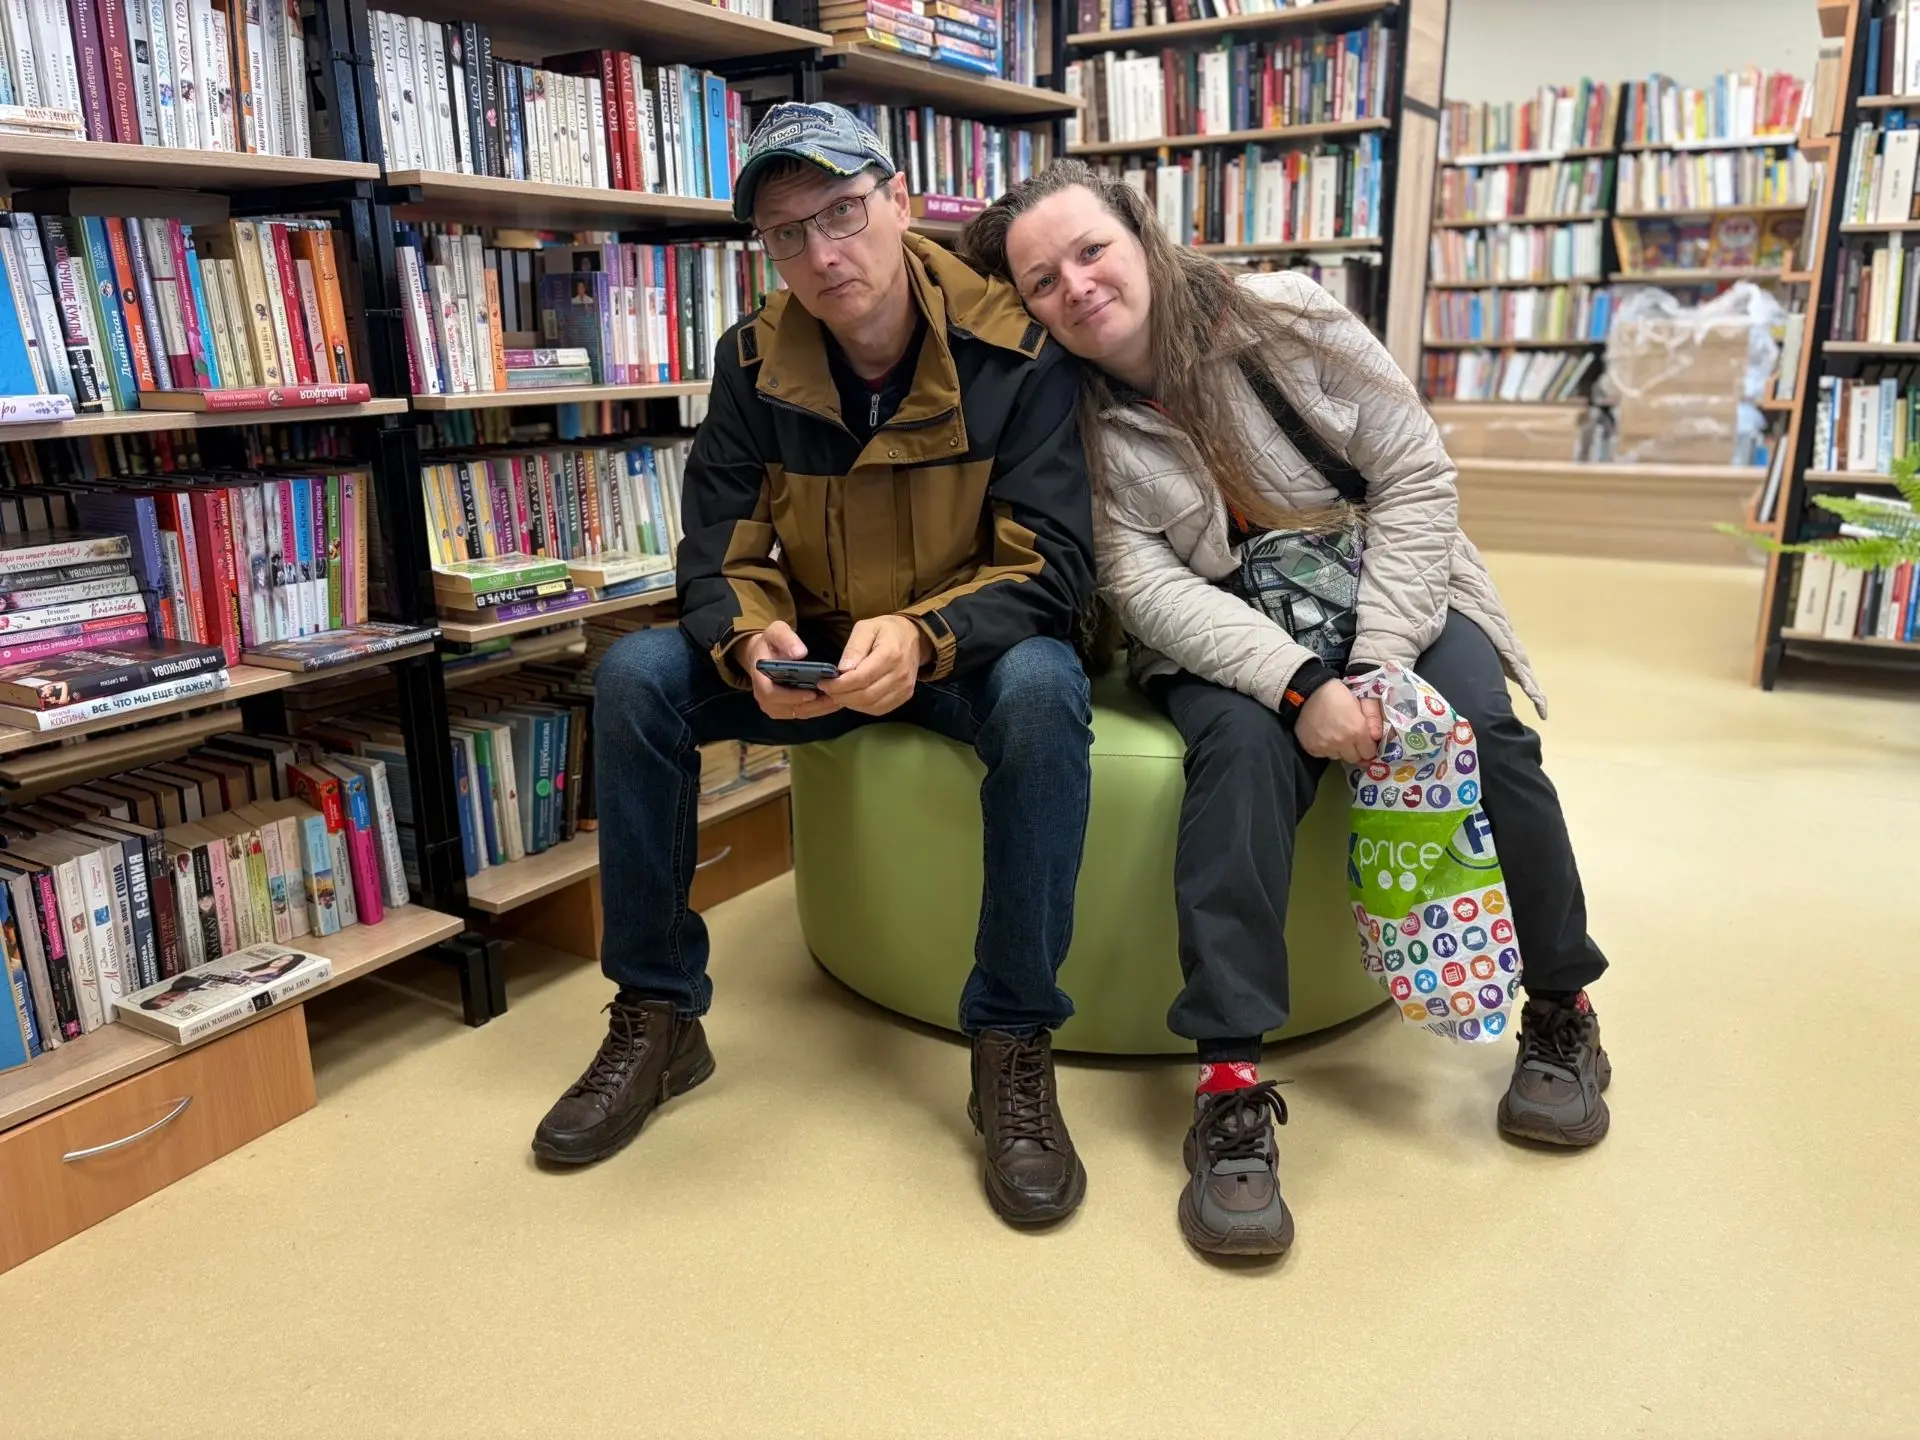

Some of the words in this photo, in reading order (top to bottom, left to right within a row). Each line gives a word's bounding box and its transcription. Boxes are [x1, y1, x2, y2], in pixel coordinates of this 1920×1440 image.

[173, 0, 192, 73] ОЛЧОК
[202, 13, 210, 38] Ирина
[465, 28, 477, 72] ОЛЕГ
[483, 36, 493, 72] ОЛЕГ
[81, 45, 100, 97] Благодарю
[91, 98, 100, 108] за
[433, 48, 447, 92] РОЙ
[604, 57, 616, 94] ОЛЕГ
[622, 58, 633, 94] ОЛЕГ
[469, 74, 480, 110] РОЙ
[486, 75, 494, 100] РОЙ
[255, 96, 264, 128] ВОРОНОВА
[608, 102, 619, 132] РОЙ
[626, 102, 636, 132] РОЙ
[55, 246, 74, 302] ХОХОЧУЩИЕ
[413, 278, 422, 308] РИСОВАТЬ
[64, 304, 84, 340] КУКЛЫ
[109, 309, 132, 378] Дивицкая
[73, 349, 90, 375] ТАТЬЯНА
[81, 373, 98, 402] ДАГОВИЧ
[299, 384, 348, 403] Дивицкая
[564, 459, 574, 492] ТРАУБ
[576, 457, 585, 491] ТРАУБ
[585, 456, 595, 487] ТРАУБ
[607, 453, 616, 483] ТРАУБ
[280, 489, 289, 530] Крюкова
[298, 487, 306, 528] Крюкова
[314, 485, 322, 525] Крюкова
[460, 482, 477, 532] ТРАУБ
[500, 491, 508, 520] ТРАУБ
[527, 473, 542, 522] ТРАУБ
[568, 495, 578, 531] МАША
[580, 494, 589, 529] МАША
[589, 492, 599, 527] МАША
[611, 487, 620, 522] МАША
[316, 527, 324, 554] Елена
[504, 520, 513, 551] МАША
[5, 558, 45, 572] КЛИМОВА
[68, 562, 112, 579] КОЛОЧКОВА
[46, 605, 71, 616] Темное
[486, 588, 520, 605] ТРАУБ
[20, 642, 49, 654] страсти
[201, 654, 216, 665] ВЕРА
[99, 677, 119, 687] СИРЕНЫ
[150, 654, 201, 680] КОЛОЧКОВА
[91, 702, 112, 715] ВСЕ,
[112, 696, 132, 709] ЧТО
[133, 692, 151, 704] МЫ
[151, 687, 174, 700] ЕЩЕ
[173, 677, 213, 696] СКАЖЕМ
[48, 710, 86, 728] КОСТИНА
[540, 722, 550, 776] Щербакова
[1360, 838, 1444, 870] price
[113, 863, 126, 897] ГОША
[127, 852, 151, 919] Я-САНИЯ
[82, 933, 98, 1002] Машкова
[101, 927, 122, 996] Машкова
[140, 944, 151, 983] МАШКОВА
[163, 946, 173, 970] ДИАНА
[12, 980, 27, 1005] Цена
[19, 1006, 35, 1039] успеха
[188, 1020, 211, 1037] ДИАНА
[210, 1005, 243, 1027] МАШКОВА
